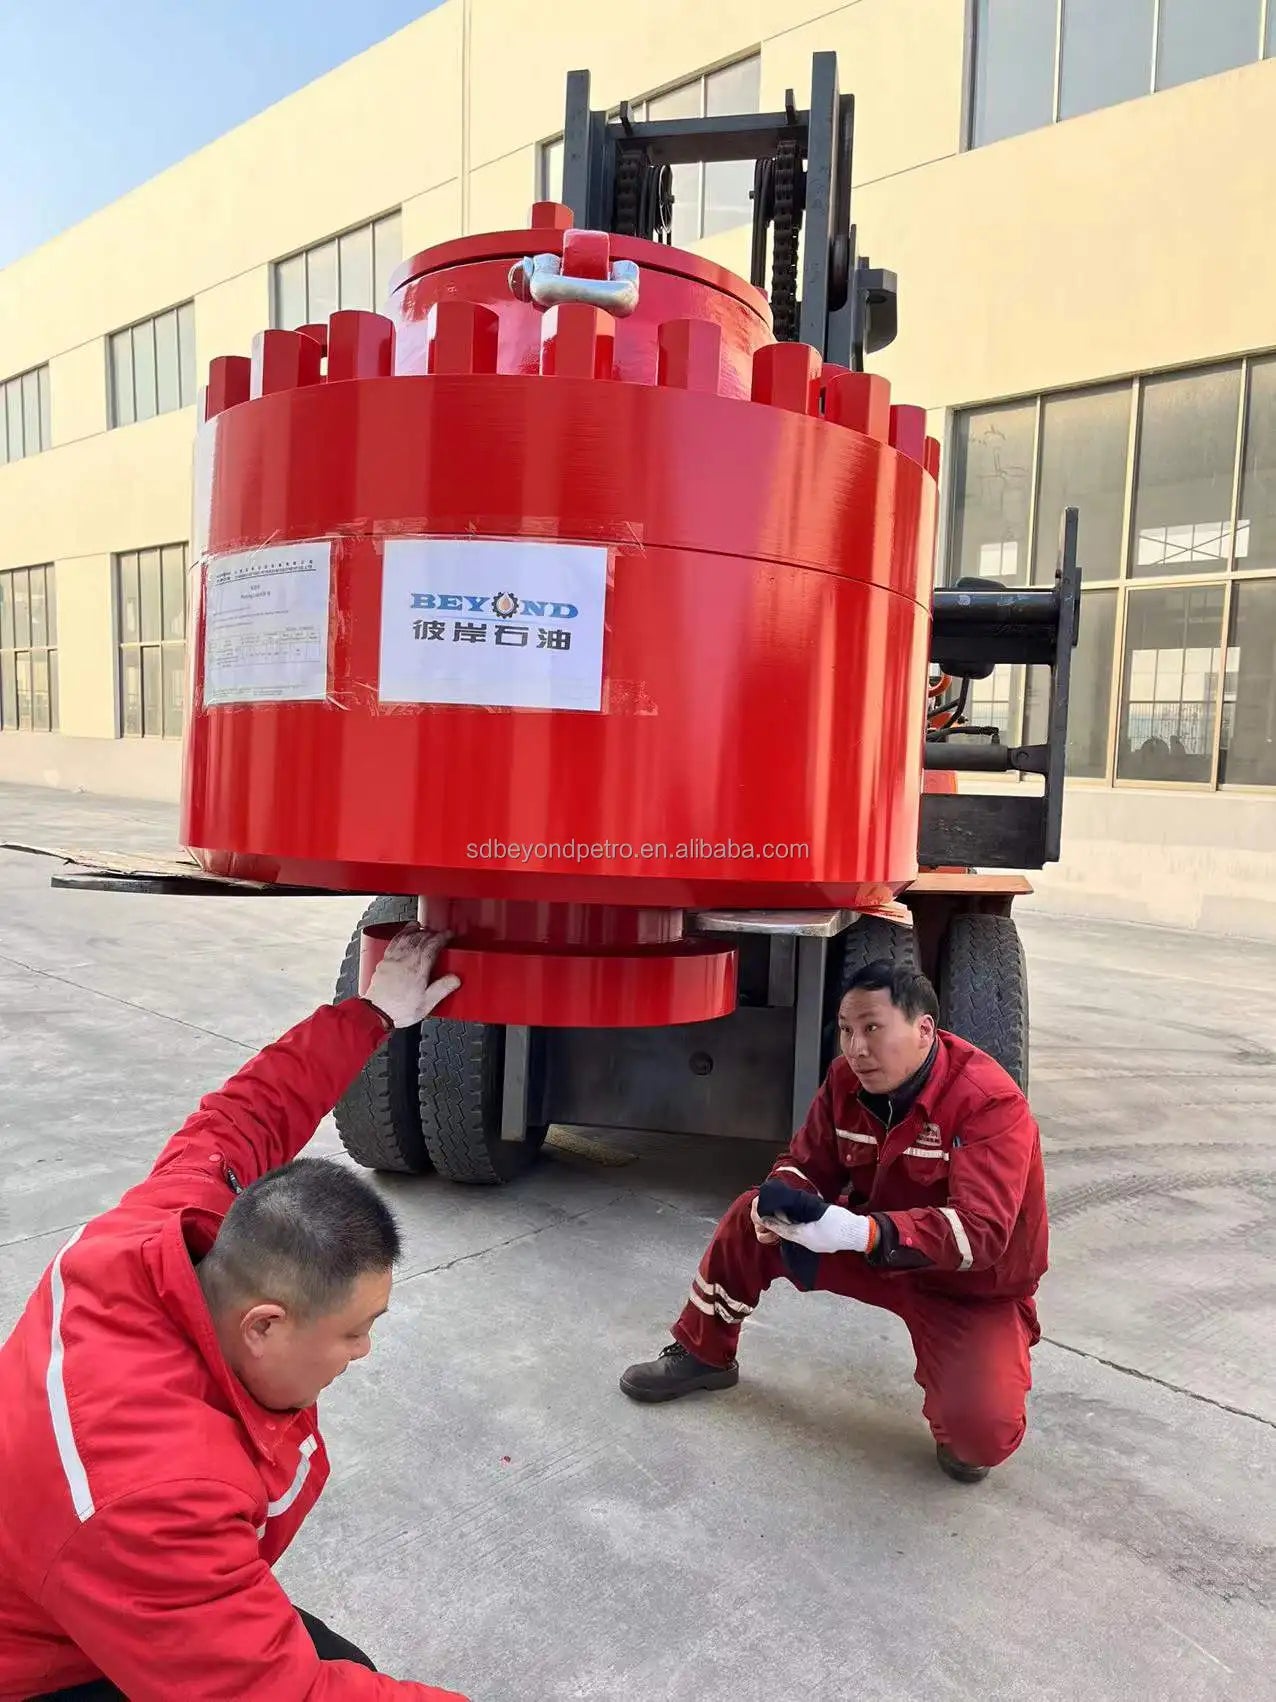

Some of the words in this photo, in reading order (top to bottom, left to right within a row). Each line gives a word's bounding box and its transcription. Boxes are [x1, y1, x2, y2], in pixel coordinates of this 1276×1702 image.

[410, 592, 579, 619] BEYOND
[412, 619, 572, 651] 彼岸石油
